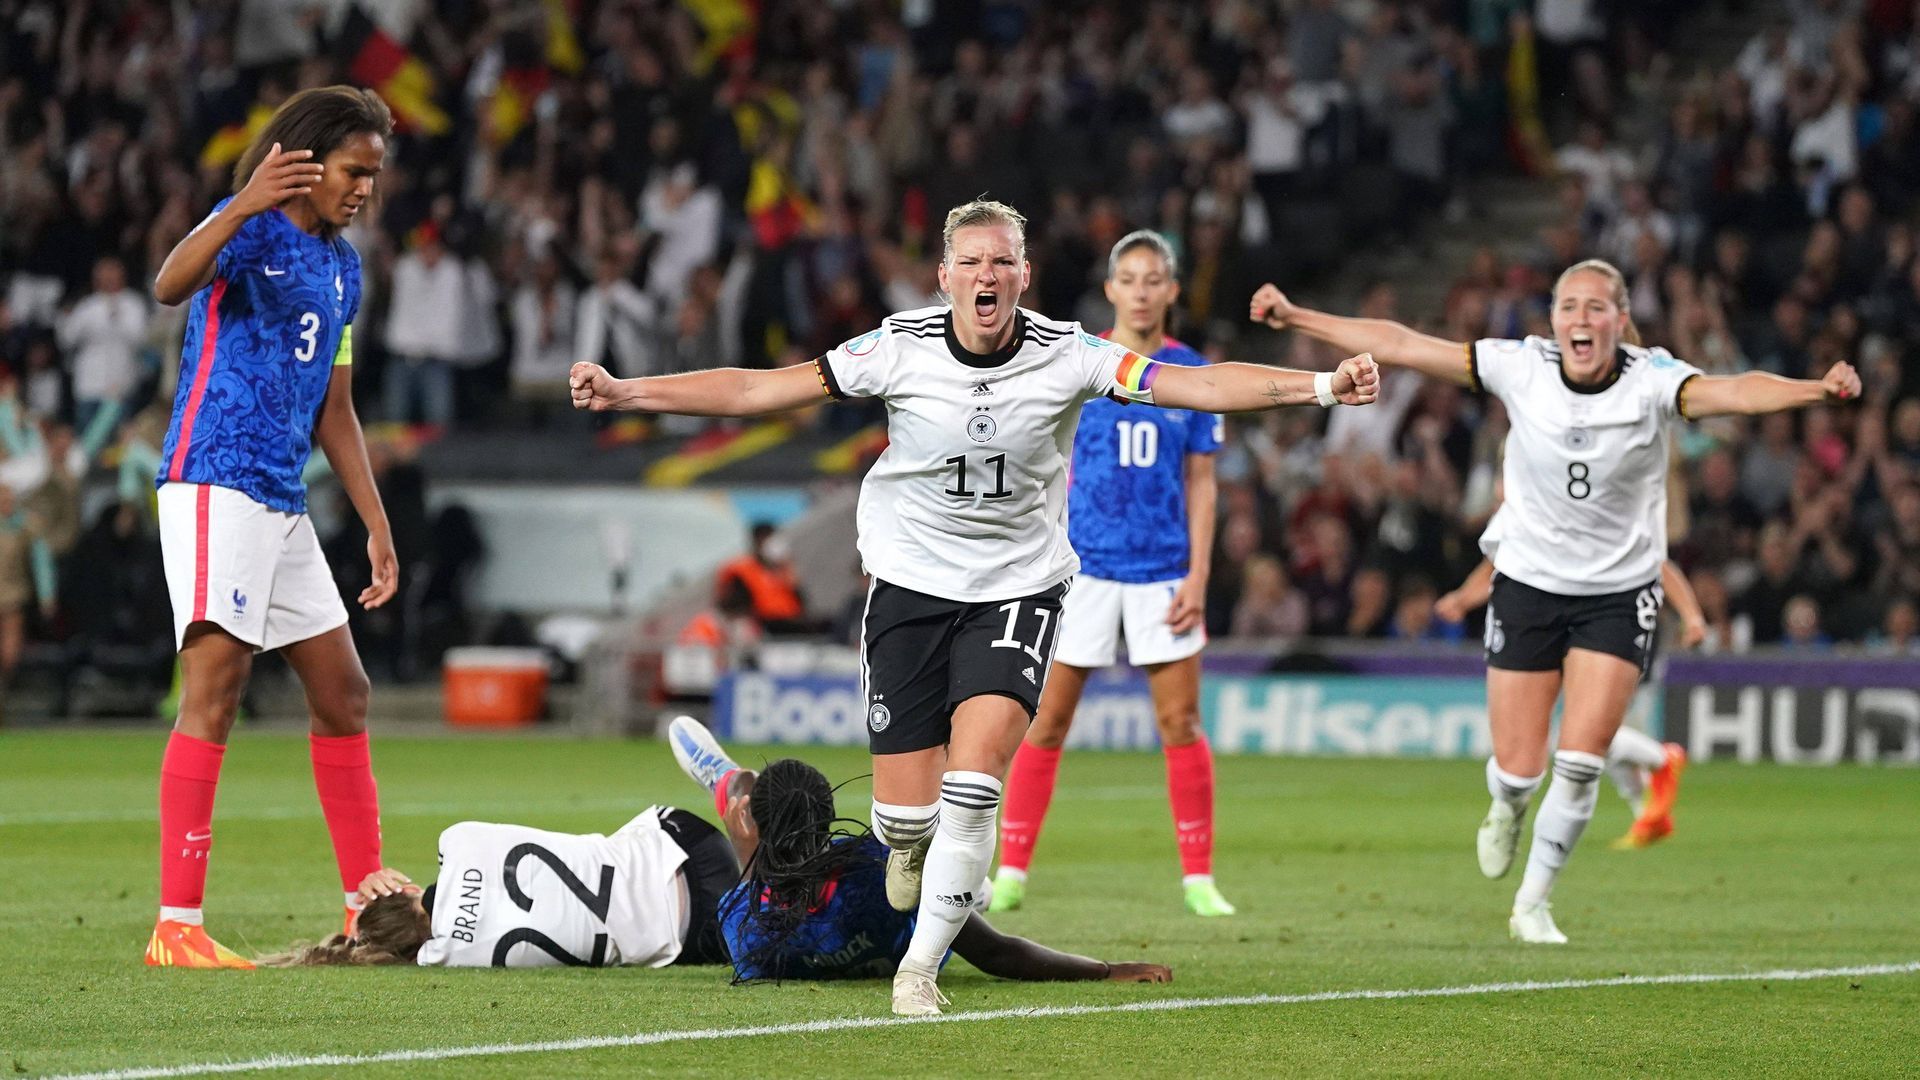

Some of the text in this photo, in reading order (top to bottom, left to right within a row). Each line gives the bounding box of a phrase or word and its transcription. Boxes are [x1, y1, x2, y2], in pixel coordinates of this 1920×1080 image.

[294, 312, 320, 362] 3
[1116, 420, 1158, 468] 10
[945, 453, 1013, 498] 11
[1567, 462, 1590, 500] 8
[990, 600, 1051, 664] 11
[451, 868, 483, 943] BRAND
[491, 842, 615, 968] 22
